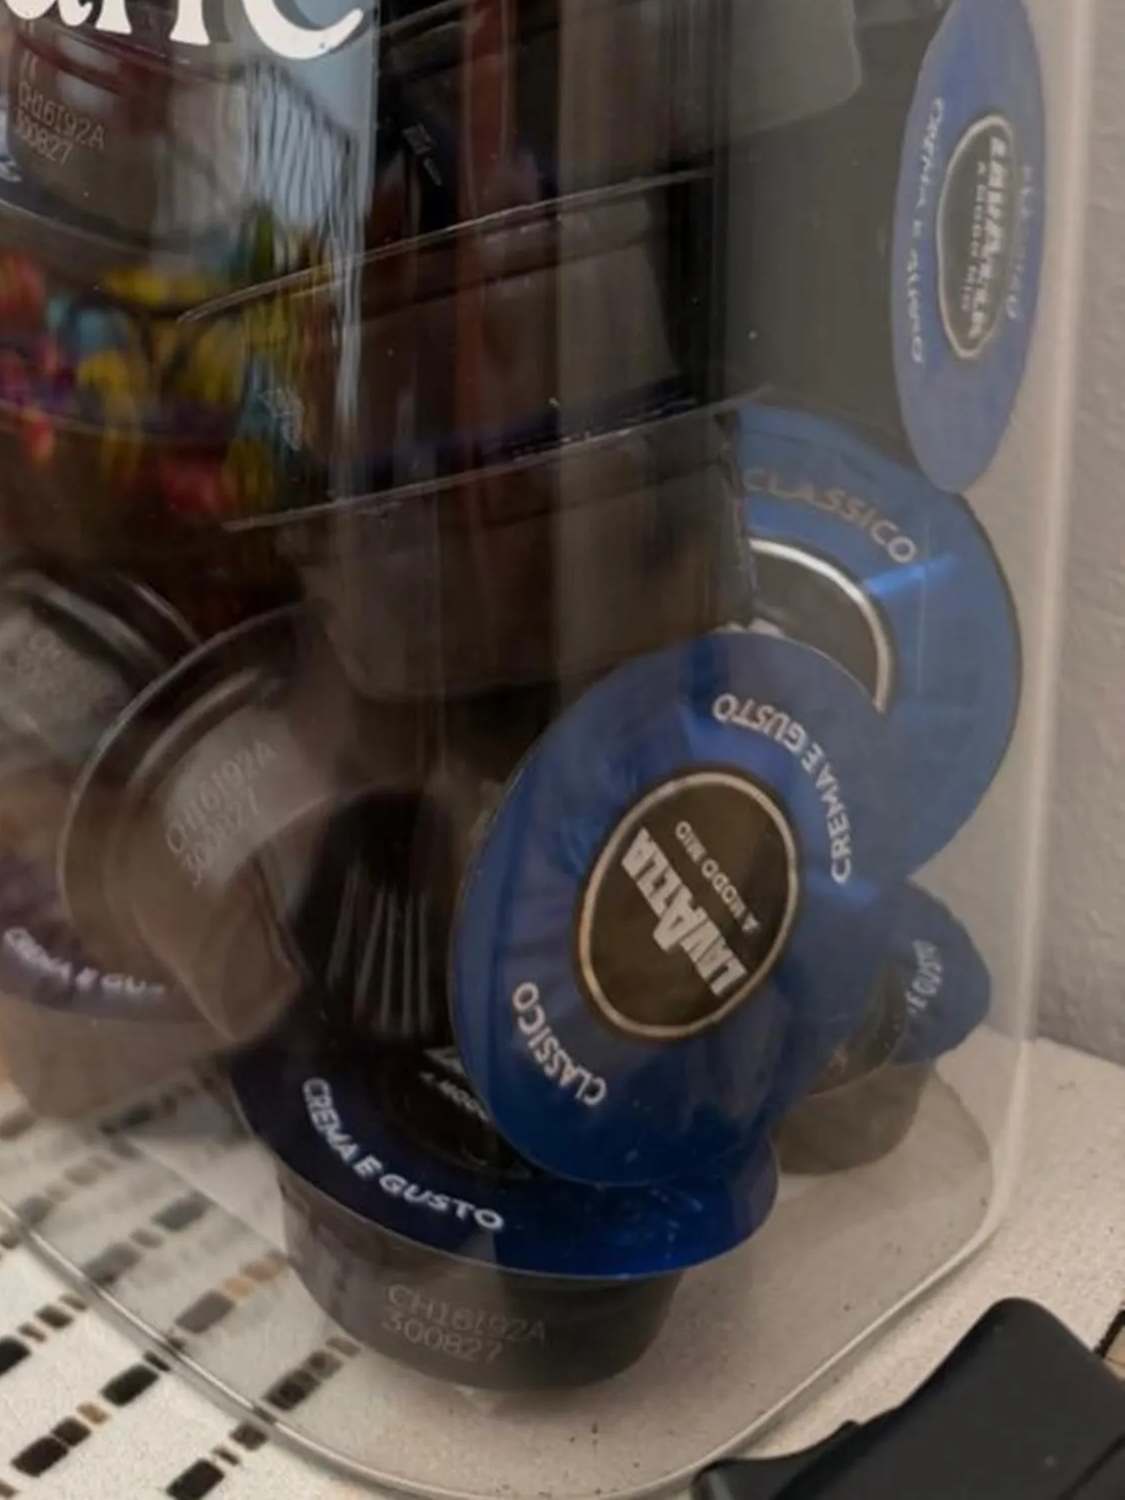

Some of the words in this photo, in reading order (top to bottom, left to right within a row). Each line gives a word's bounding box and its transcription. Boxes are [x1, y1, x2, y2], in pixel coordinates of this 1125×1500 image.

[743, 466, 917, 564] CLASSICO
[711, 692, 808, 755] GUSTO
[800, 741, 825, 775] E
[675, 819, 709, 864] MIO
[815, 763, 853, 886] CREMA
[621, 826, 748, 997] LAVAZZA
[701, 857, 747, 921] MODO
[511, 981, 608, 1106] CLASSICO
[301, 1076, 360, 1164] CREMA
[352, 1154, 383, 1180] E
[378, 1172, 506, 1232] GUSTO
